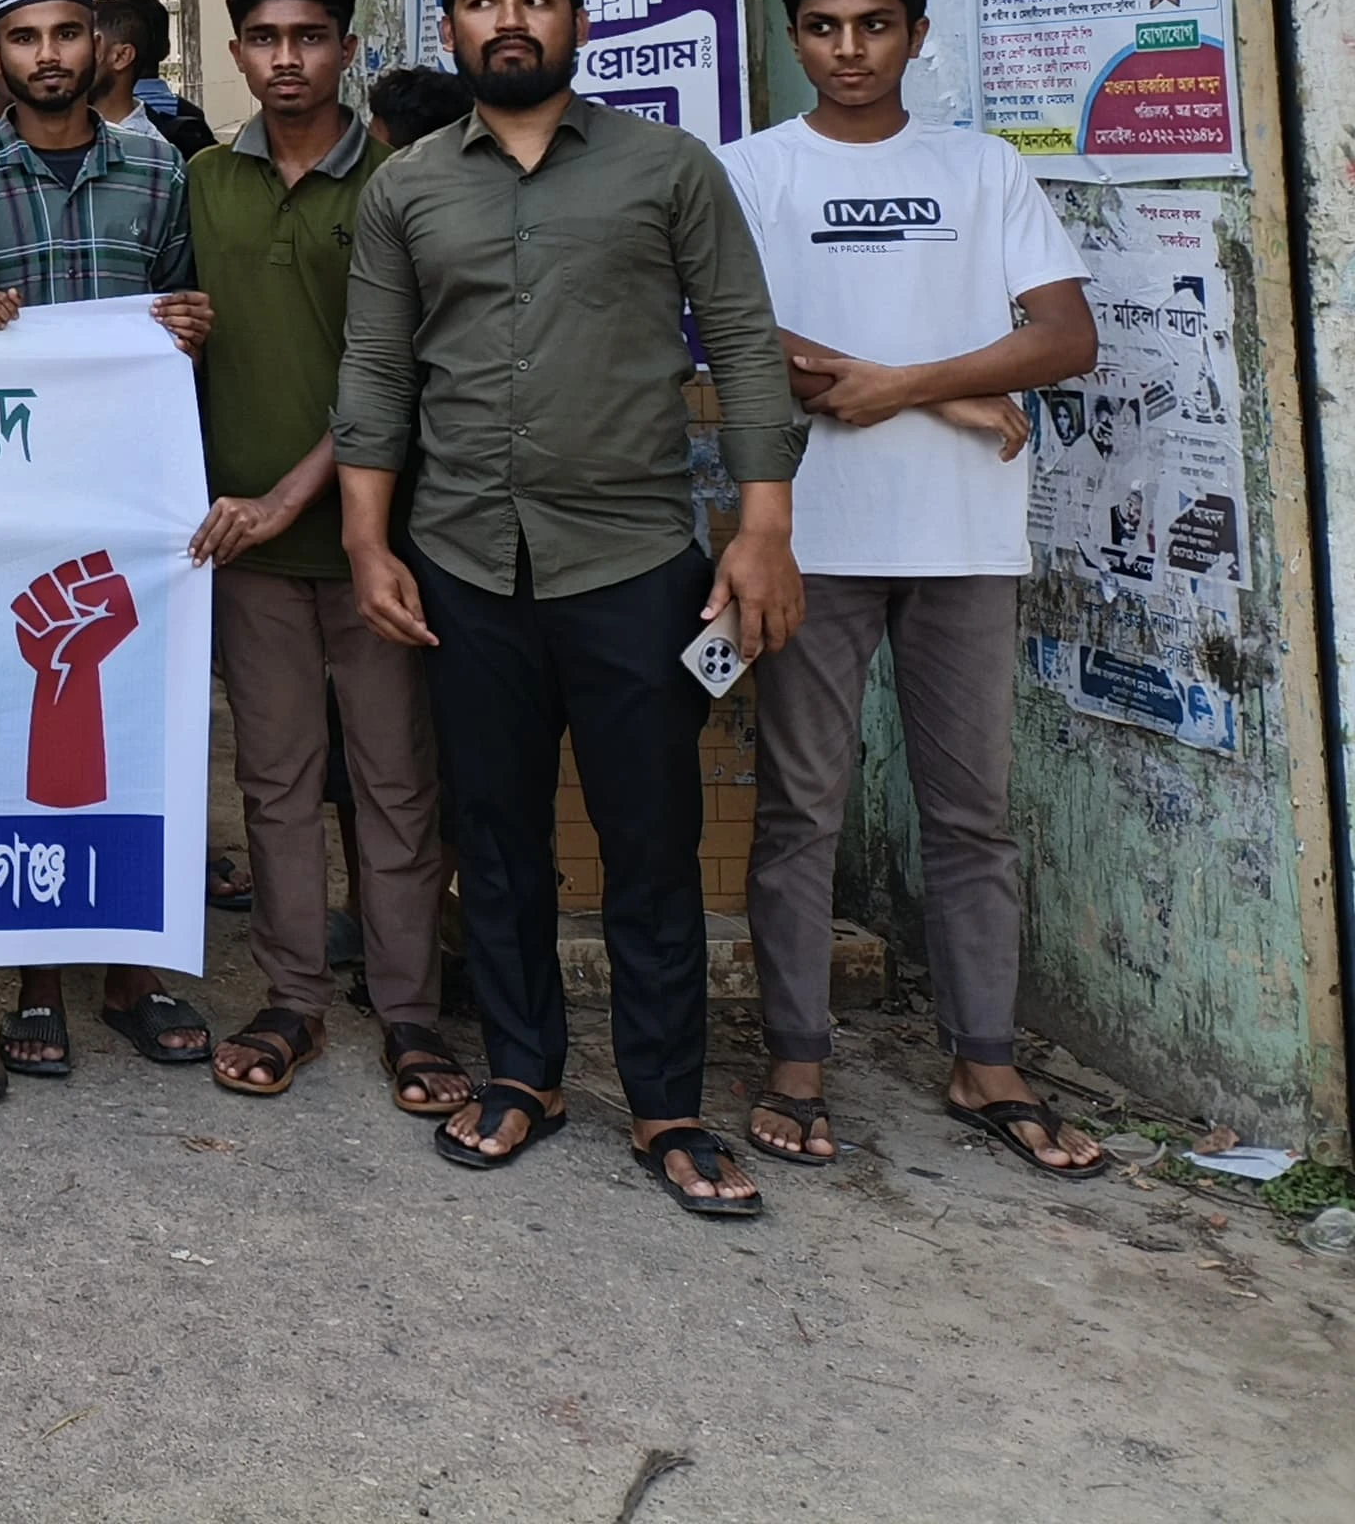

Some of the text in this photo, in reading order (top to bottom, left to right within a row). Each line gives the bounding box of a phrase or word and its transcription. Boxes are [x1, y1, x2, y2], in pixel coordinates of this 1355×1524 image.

[1139, 24, 1195, 46] যোগাযোগ
[586, 36, 712, 80] প্রোগ্রাম ২০২৬
[828, 201, 936, 223] IMAN
[828, 245, 838, 254] IN
